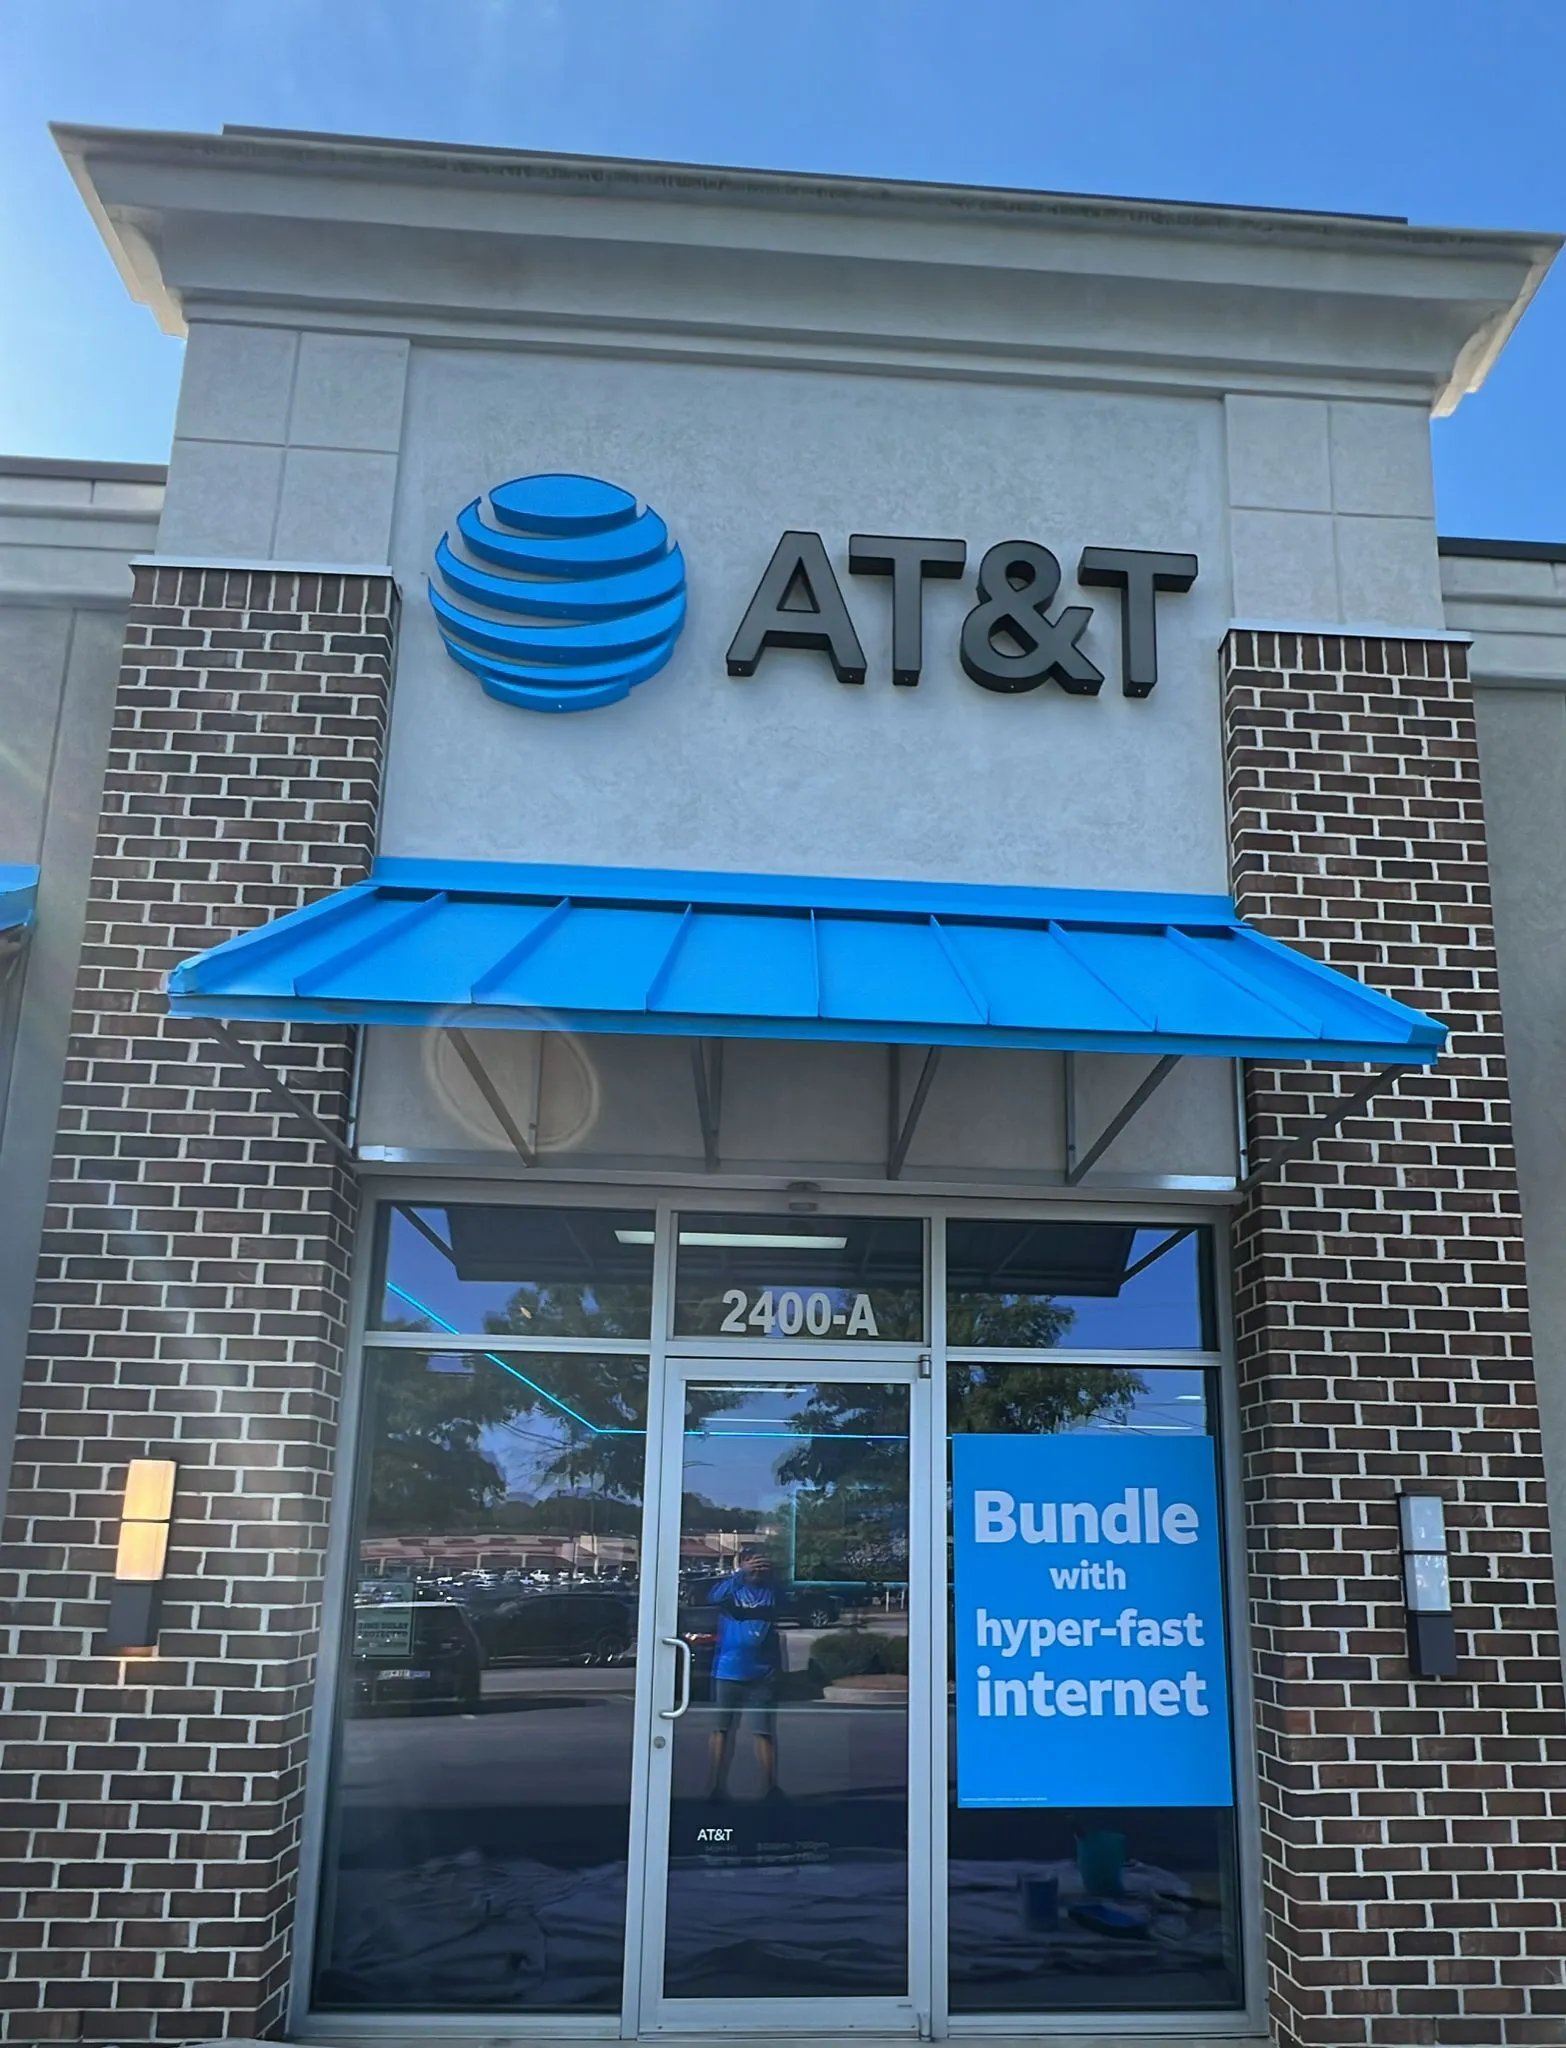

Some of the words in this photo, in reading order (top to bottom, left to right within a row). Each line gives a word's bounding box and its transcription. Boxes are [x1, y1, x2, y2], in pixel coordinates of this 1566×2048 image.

[726, 530, 1198, 698] AT&T
[720, 1289, 879, 1336] 2400-A
[974, 1488, 1200, 1545] Bundle
[1050, 1560, 1126, 1590] with
[976, 1608, 1205, 1657] hyper-fast
[977, 1665, 1209, 1716] internet
[697, 1829, 733, 1841] AT&T
